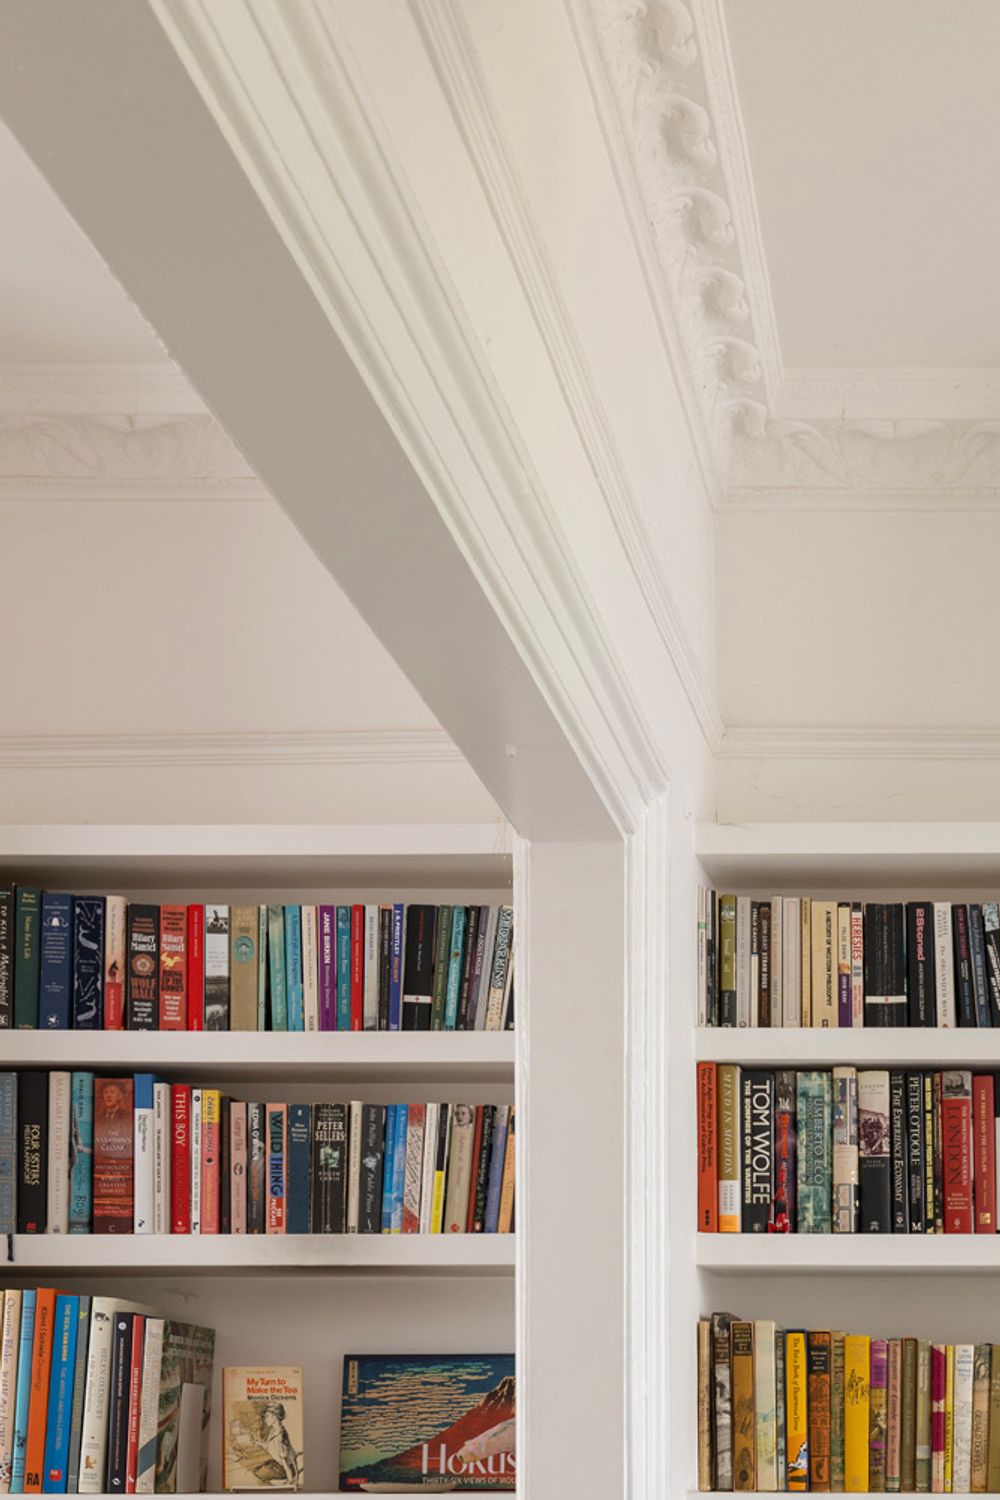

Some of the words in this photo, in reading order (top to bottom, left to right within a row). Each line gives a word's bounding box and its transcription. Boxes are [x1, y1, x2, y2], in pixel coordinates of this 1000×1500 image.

[175, 1092, 185, 1120] THIS
[753, 1080, 770, 1126] TOM
[893, 1088, 902, 1106] THE
[910, 1077, 920, 1113] PETER
[175, 1123, 185, 1147] BOY
[893, 1109, 903, 1157] EXPERIENCE
[910, 1115, 921, 1165] O'TOOLE
[946, 1106, 961, 1184] LONDON
[753, 1131, 770, 1204] WOLFE
[894, 1160, 904, 1202] ECONOMY
